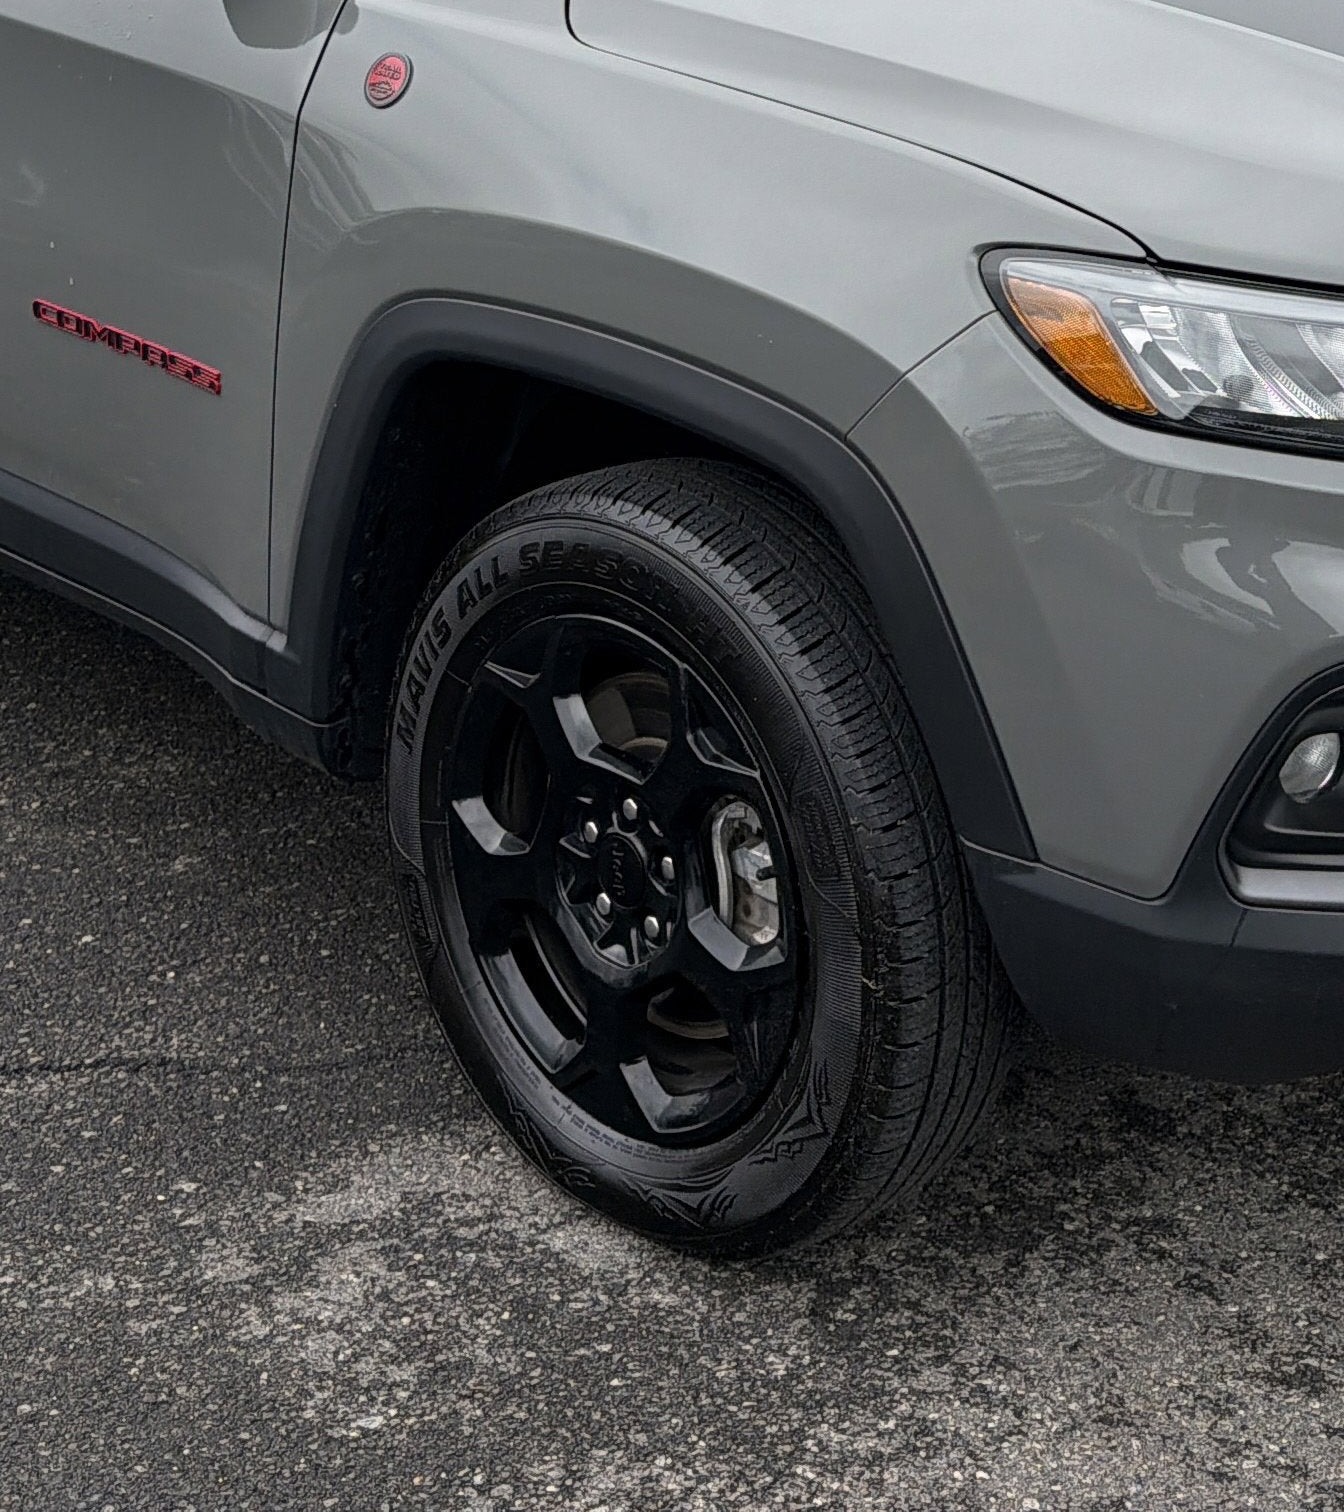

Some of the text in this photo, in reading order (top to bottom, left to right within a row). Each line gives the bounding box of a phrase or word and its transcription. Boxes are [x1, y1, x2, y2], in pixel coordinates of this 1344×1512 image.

[33, 298, 222, 396] COMPASS
[394, 612, 453, 755] MAVIS
[454, 555, 511, 621] ALL
